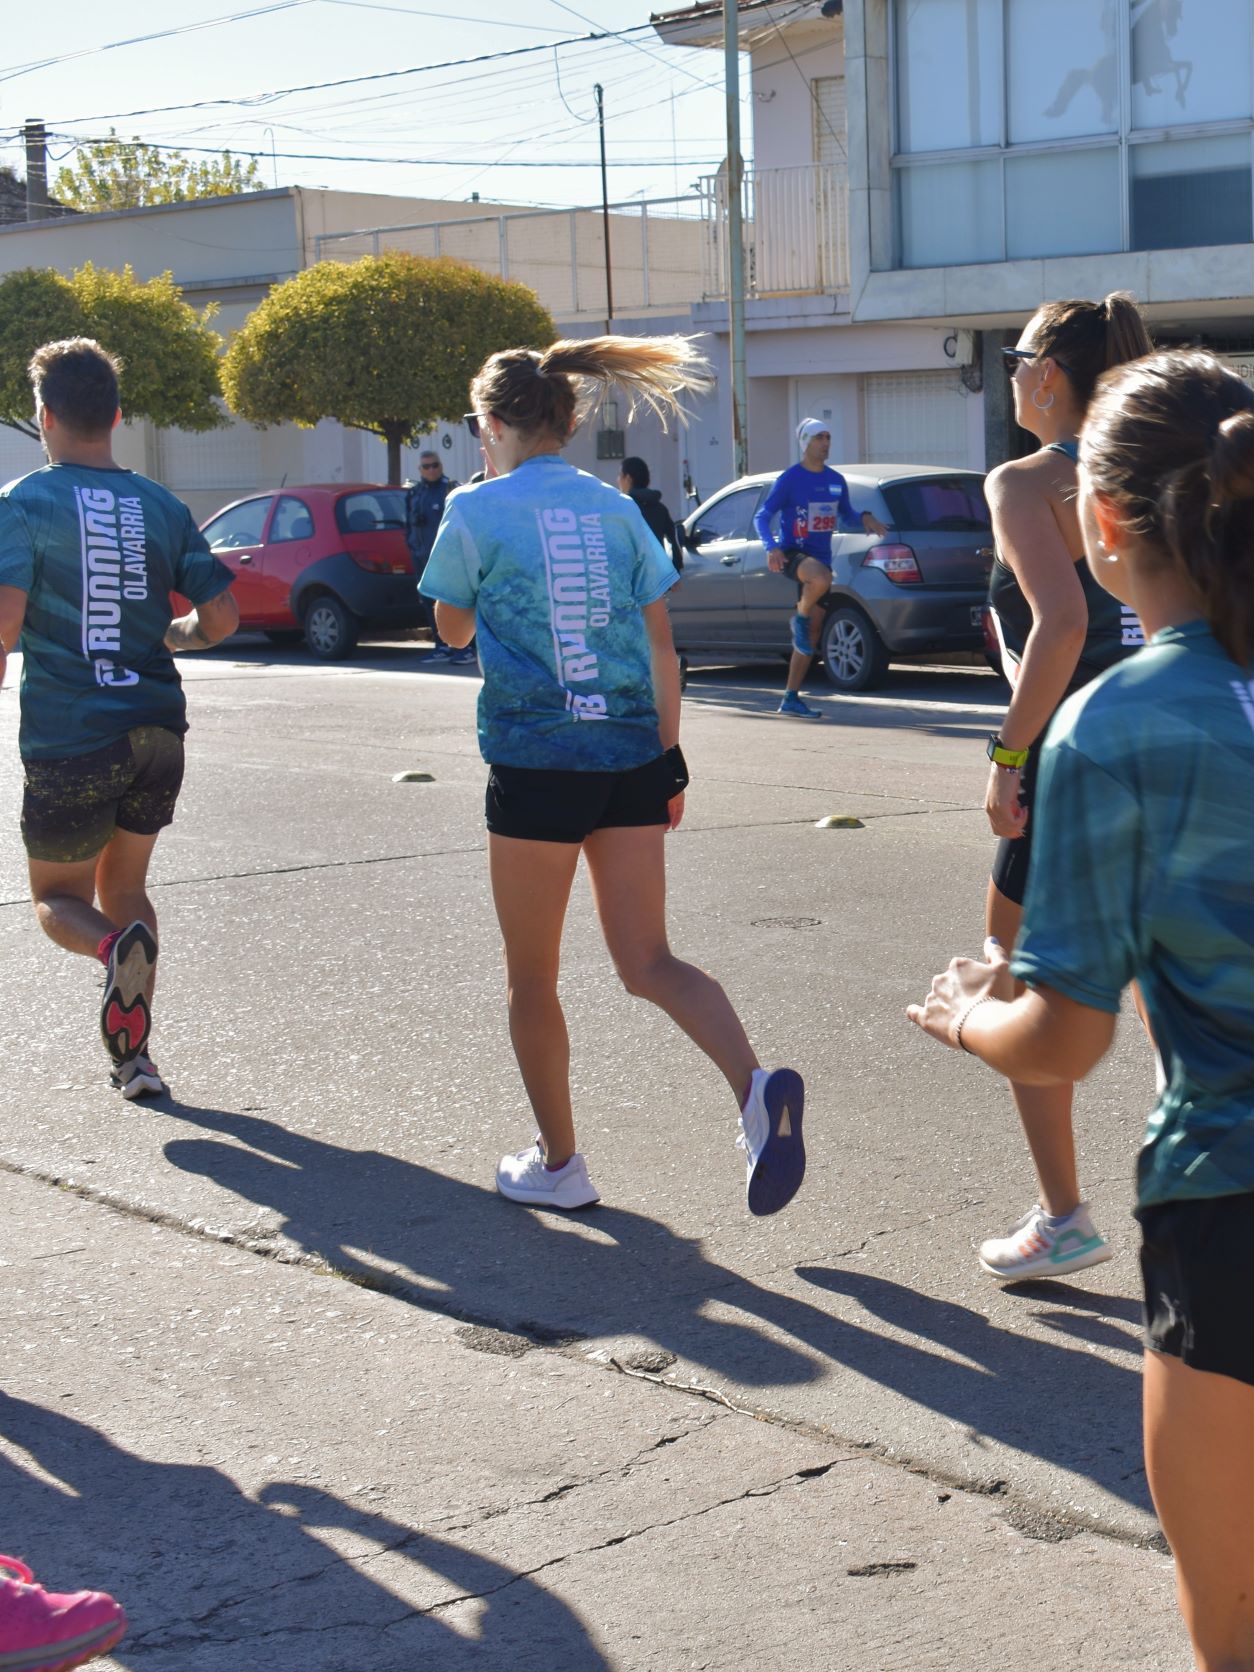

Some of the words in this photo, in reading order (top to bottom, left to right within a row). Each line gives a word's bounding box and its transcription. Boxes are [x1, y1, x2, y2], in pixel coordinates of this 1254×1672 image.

[81, 487, 122, 651] RUNNING
[118, 496, 148, 600] OLAVARRIA
[542, 507, 600, 682] RUNNING
[579, 512, 612, 628] OLAVARRIA
